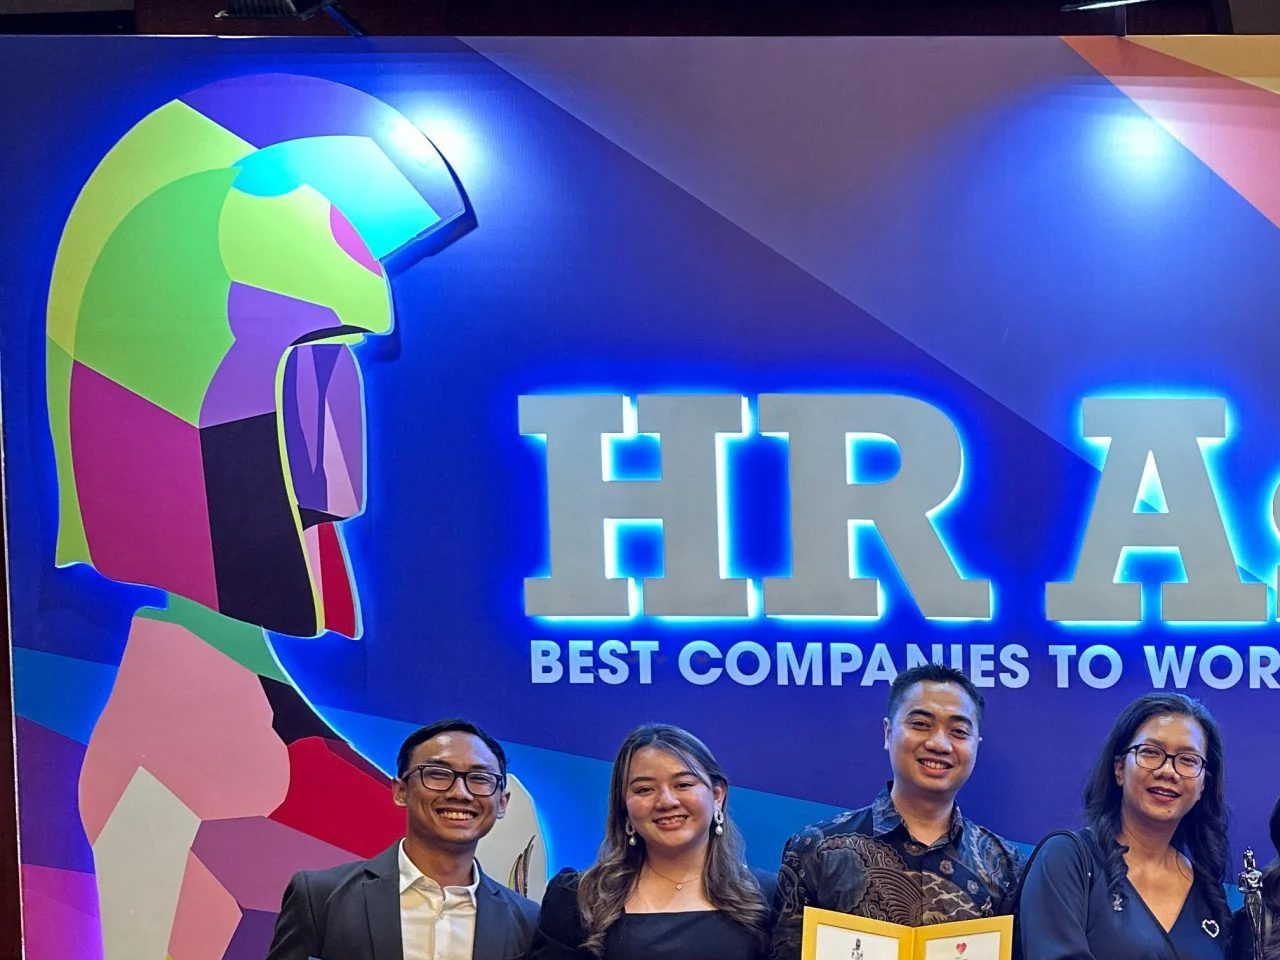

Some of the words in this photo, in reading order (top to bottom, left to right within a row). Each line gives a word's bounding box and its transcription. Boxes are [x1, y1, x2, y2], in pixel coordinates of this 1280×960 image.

[518, 394, 993, 620] HR
[530, 640, 660, 684] BEST
[679, 641, 1030, 689] COMPANIES
[1048, 645, 1123, 689] TO
